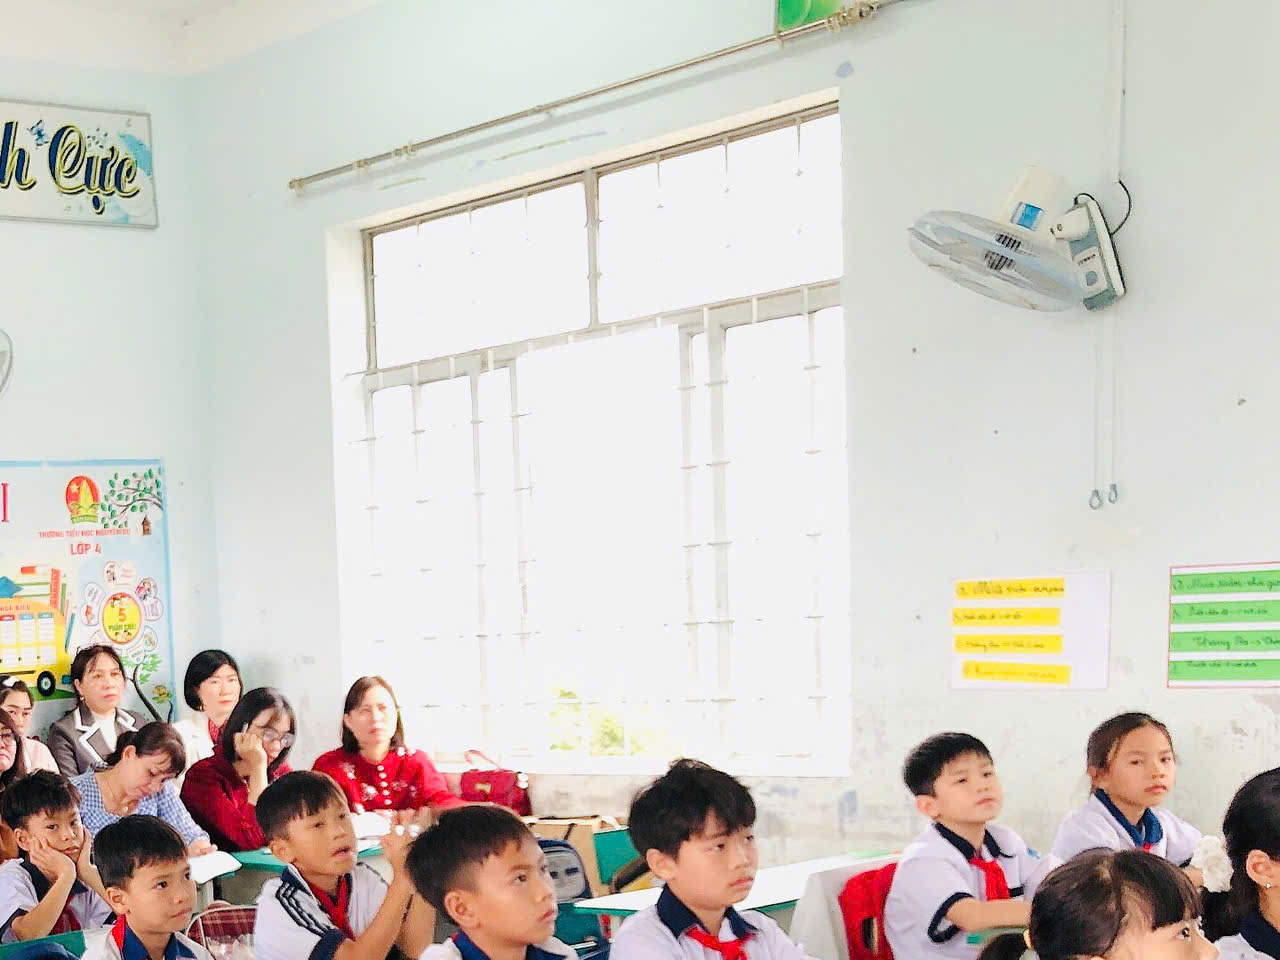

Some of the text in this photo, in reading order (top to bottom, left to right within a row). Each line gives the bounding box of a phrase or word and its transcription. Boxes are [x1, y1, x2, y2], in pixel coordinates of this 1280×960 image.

[47, 119, 141, 215] Cực
[70, 542, 91, 555] LỚP
[118, 607, 128, 622] 5
